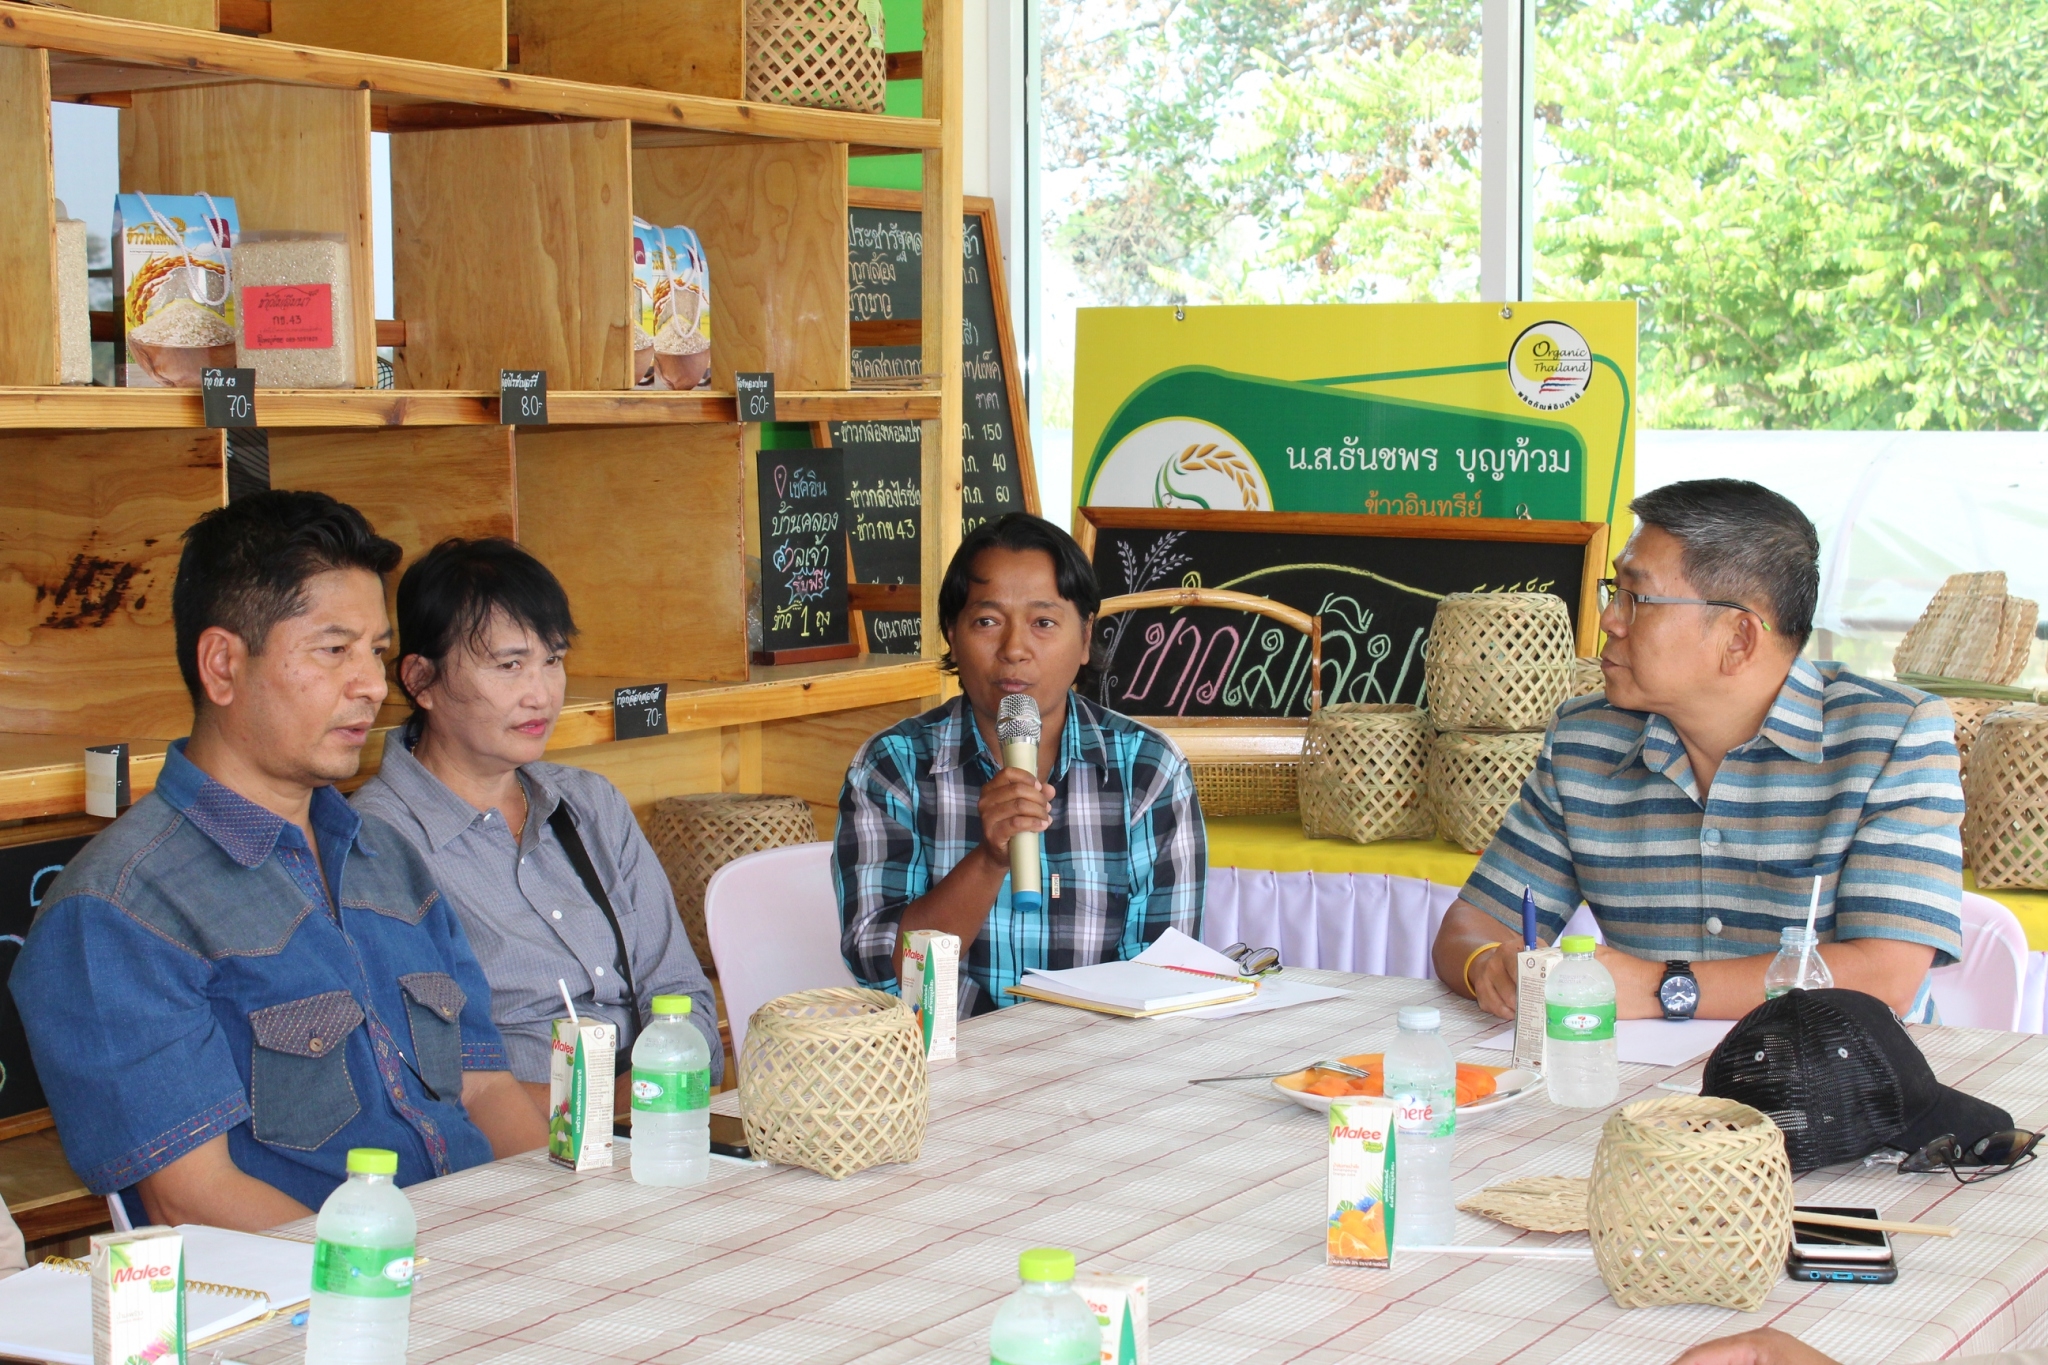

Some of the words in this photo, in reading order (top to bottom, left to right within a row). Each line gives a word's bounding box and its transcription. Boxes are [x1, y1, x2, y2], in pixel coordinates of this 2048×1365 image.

[848, 252, 897, 285] าวกล้อง
[1533, 340, 1587, 360] Organic
[1534, 362, 1588, 373] Thailand
[982, 423, 1002, 441] 150
[992, 452, 1006, 473] 40
[1456, 437, 1570, 482] บุญท้วม
[996, 486, 1009, 503] 60
[1365, 490, 1483, 518] ข้าวอินทรีย์
[771, 501, 839, 537] บ้านคลอง
[897, 519, 916, 539] 43
[772, 603, 799, 631] ข้าว
[801, 605, 810, 637] 1
[816, 610, 831, 636] ถุง
[903, 948, 924, 962] Malee
[552, 1039, 574, 1054] Malee
[1397, 1104, 1434, 1121] neré
[1332, 1126, 1382, 1140] Malee
[113, 1264, 171, 1284] Malee
[1087, 1299, 1108, 1313] ee
